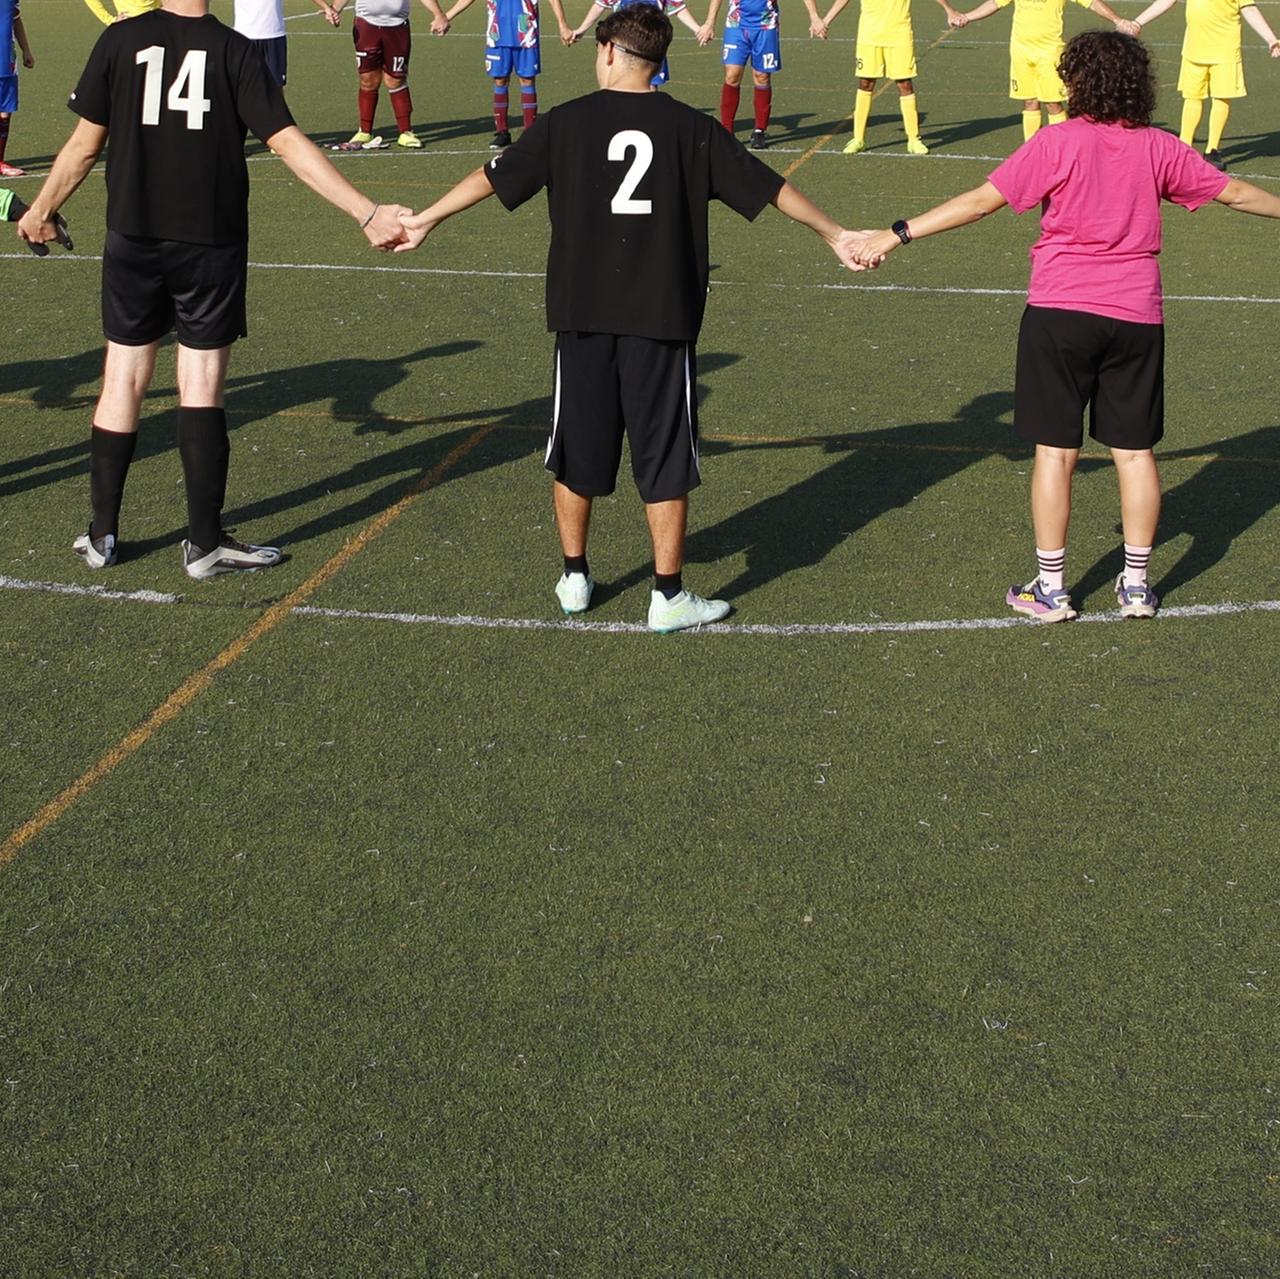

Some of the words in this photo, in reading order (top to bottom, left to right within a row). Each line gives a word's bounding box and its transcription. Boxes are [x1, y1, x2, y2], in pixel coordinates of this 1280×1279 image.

[393, 56, 404, 71] 12
[763, 52, 775, 69] 12
[136, 45, 210, 130] 14
[607, 130, 653, 214] 2
